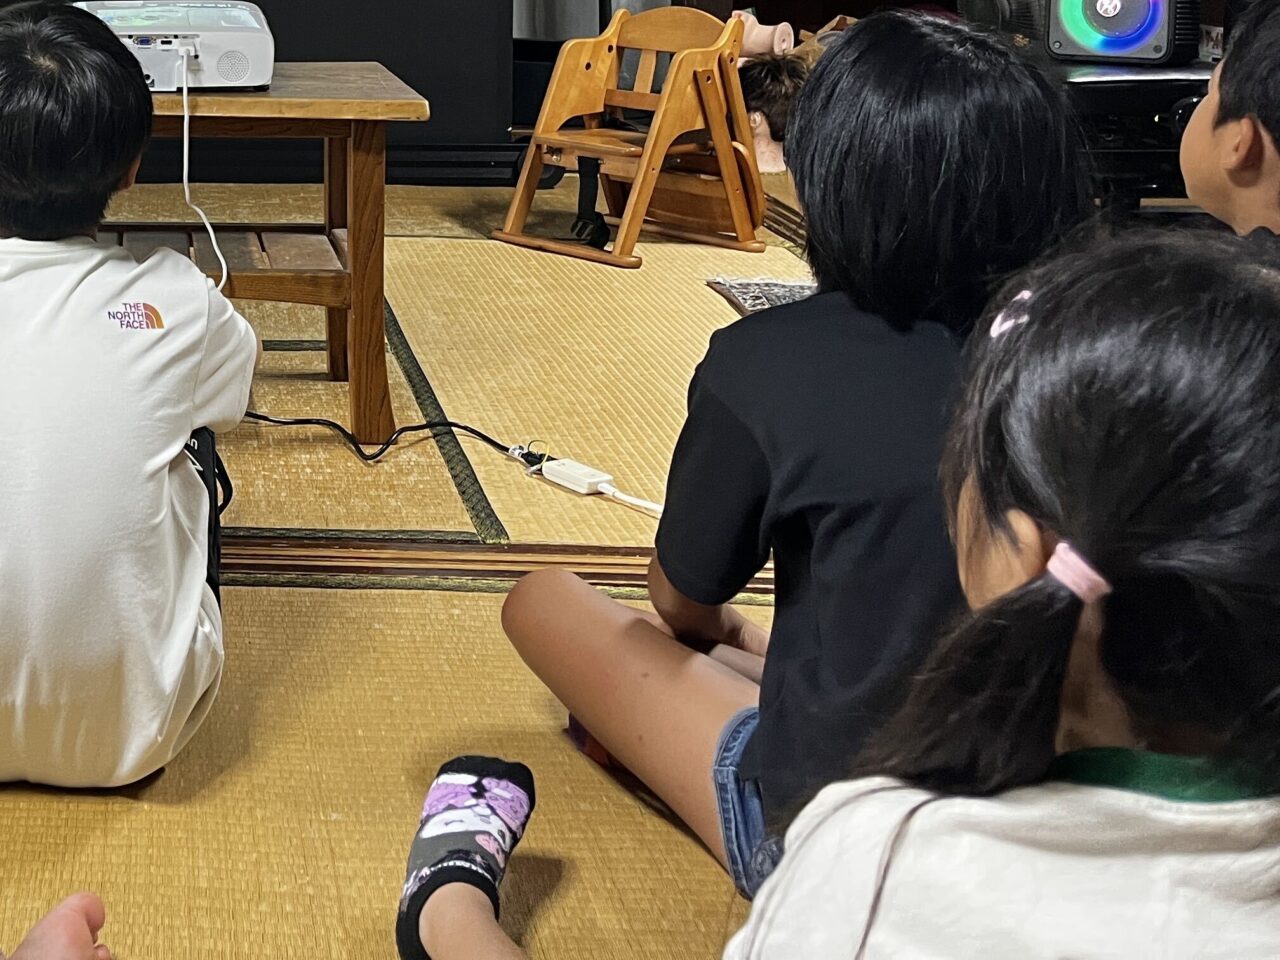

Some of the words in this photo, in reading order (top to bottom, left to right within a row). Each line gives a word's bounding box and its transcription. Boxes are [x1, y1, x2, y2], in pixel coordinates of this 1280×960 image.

[122, 303, 142, 311] THE
[108, 311, 144, 320] NORTH
[120, 320, 145, 329] FACE
